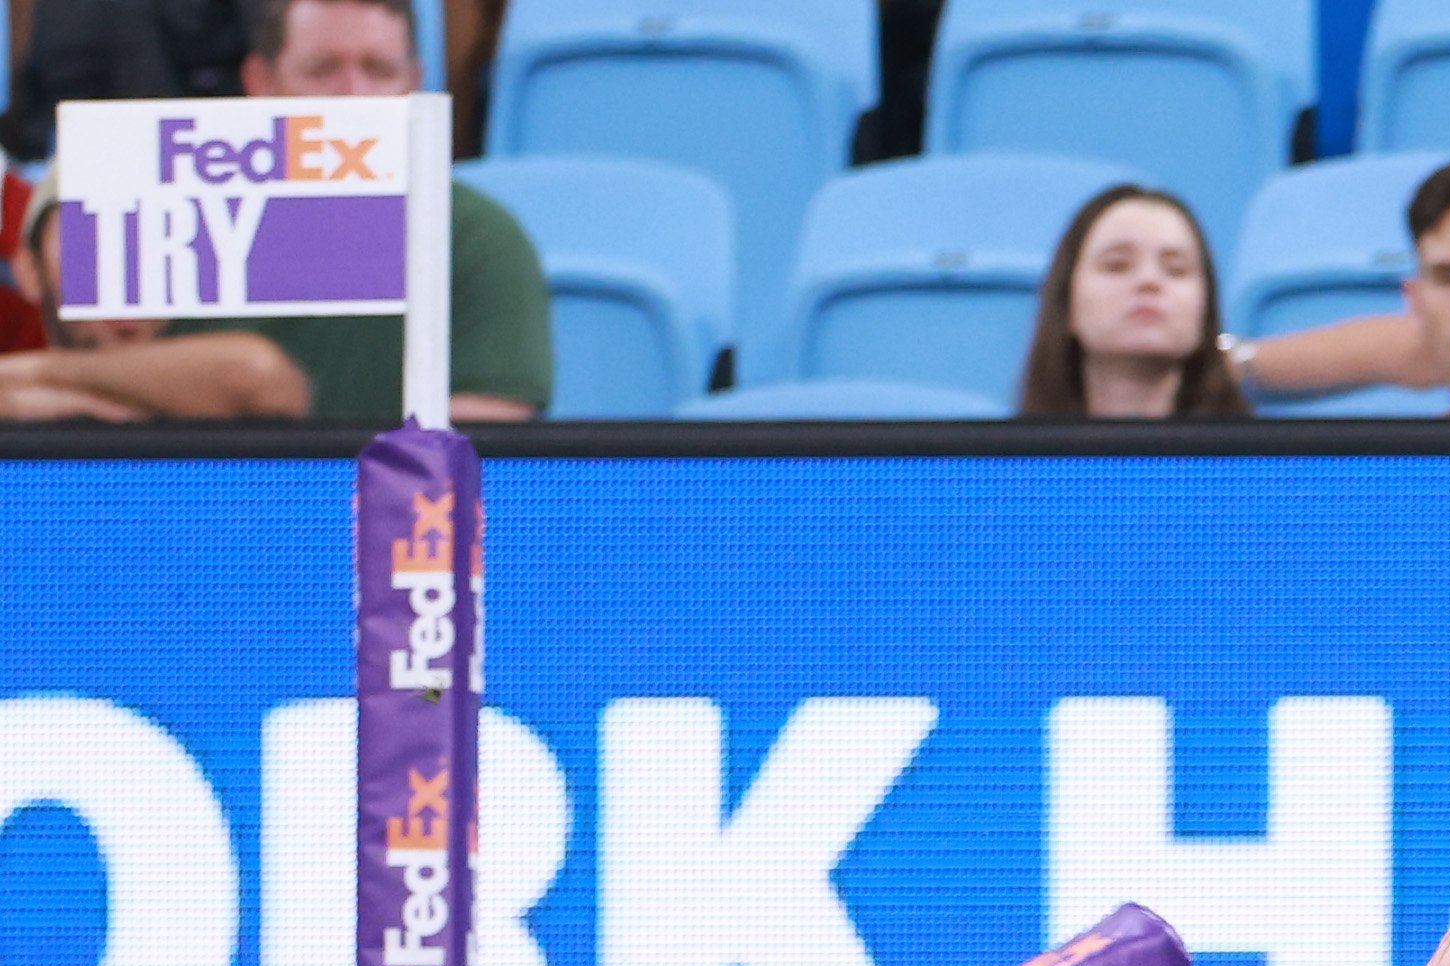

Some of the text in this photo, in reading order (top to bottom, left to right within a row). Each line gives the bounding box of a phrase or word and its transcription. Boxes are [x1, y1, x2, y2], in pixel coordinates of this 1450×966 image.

[157, 115, 379, 184] FedEx
[84, 197, 268, 306] TRY
[390, 491, 456, 690] FedEx
